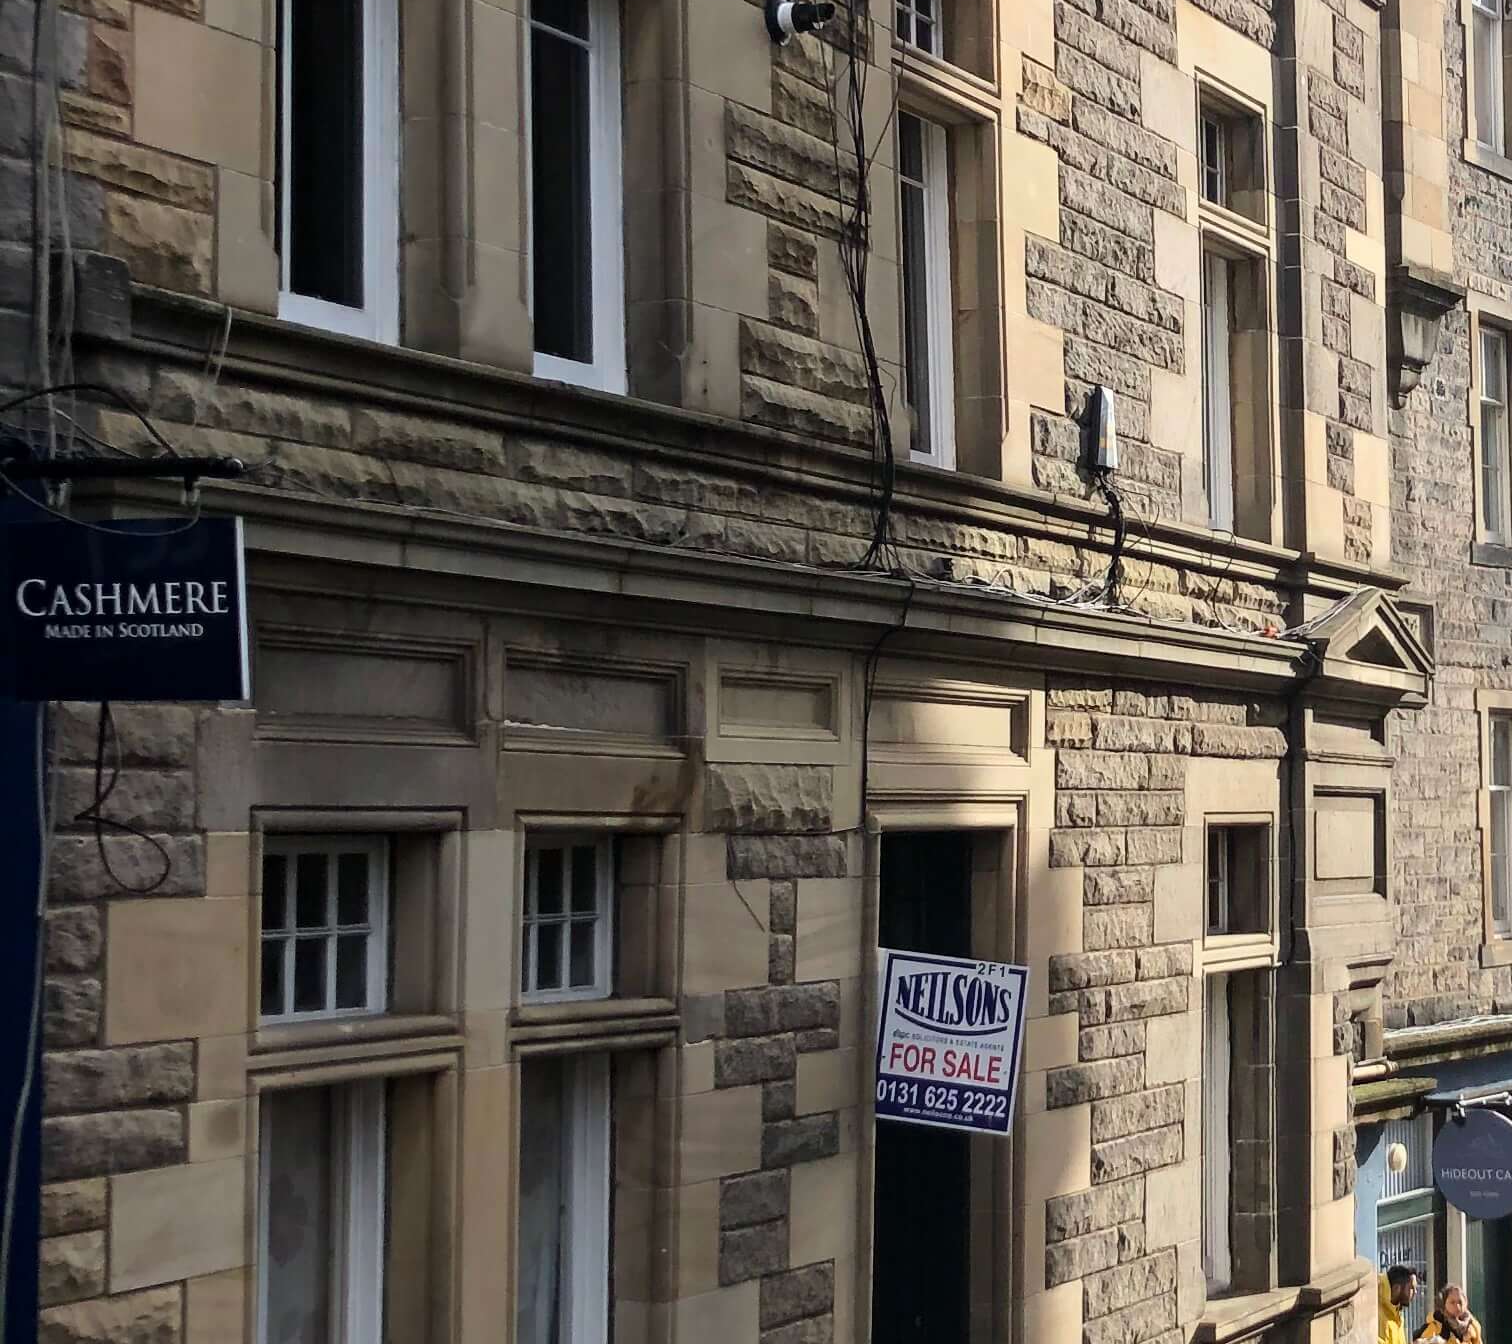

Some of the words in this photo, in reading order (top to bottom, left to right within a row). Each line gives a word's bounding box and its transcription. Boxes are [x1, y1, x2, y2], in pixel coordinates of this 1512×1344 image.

[16, 579, 229, 617] CASHMERE
[44, 624, 91, 639] MADE
[95, 624, 114, 638] IN
[119, 622, 204, 638] SCOTLAND
[895, 971, 1012, 1027] NEILSONS
[889, 1042, 937, 1075] FOR
[942, 1049, 1003, 1084] SALE
[876, 1079, 919, 1106] 0131
[925, 1085, 959, 1111] 625
[962, 1091, 1007, 1118] 2222
